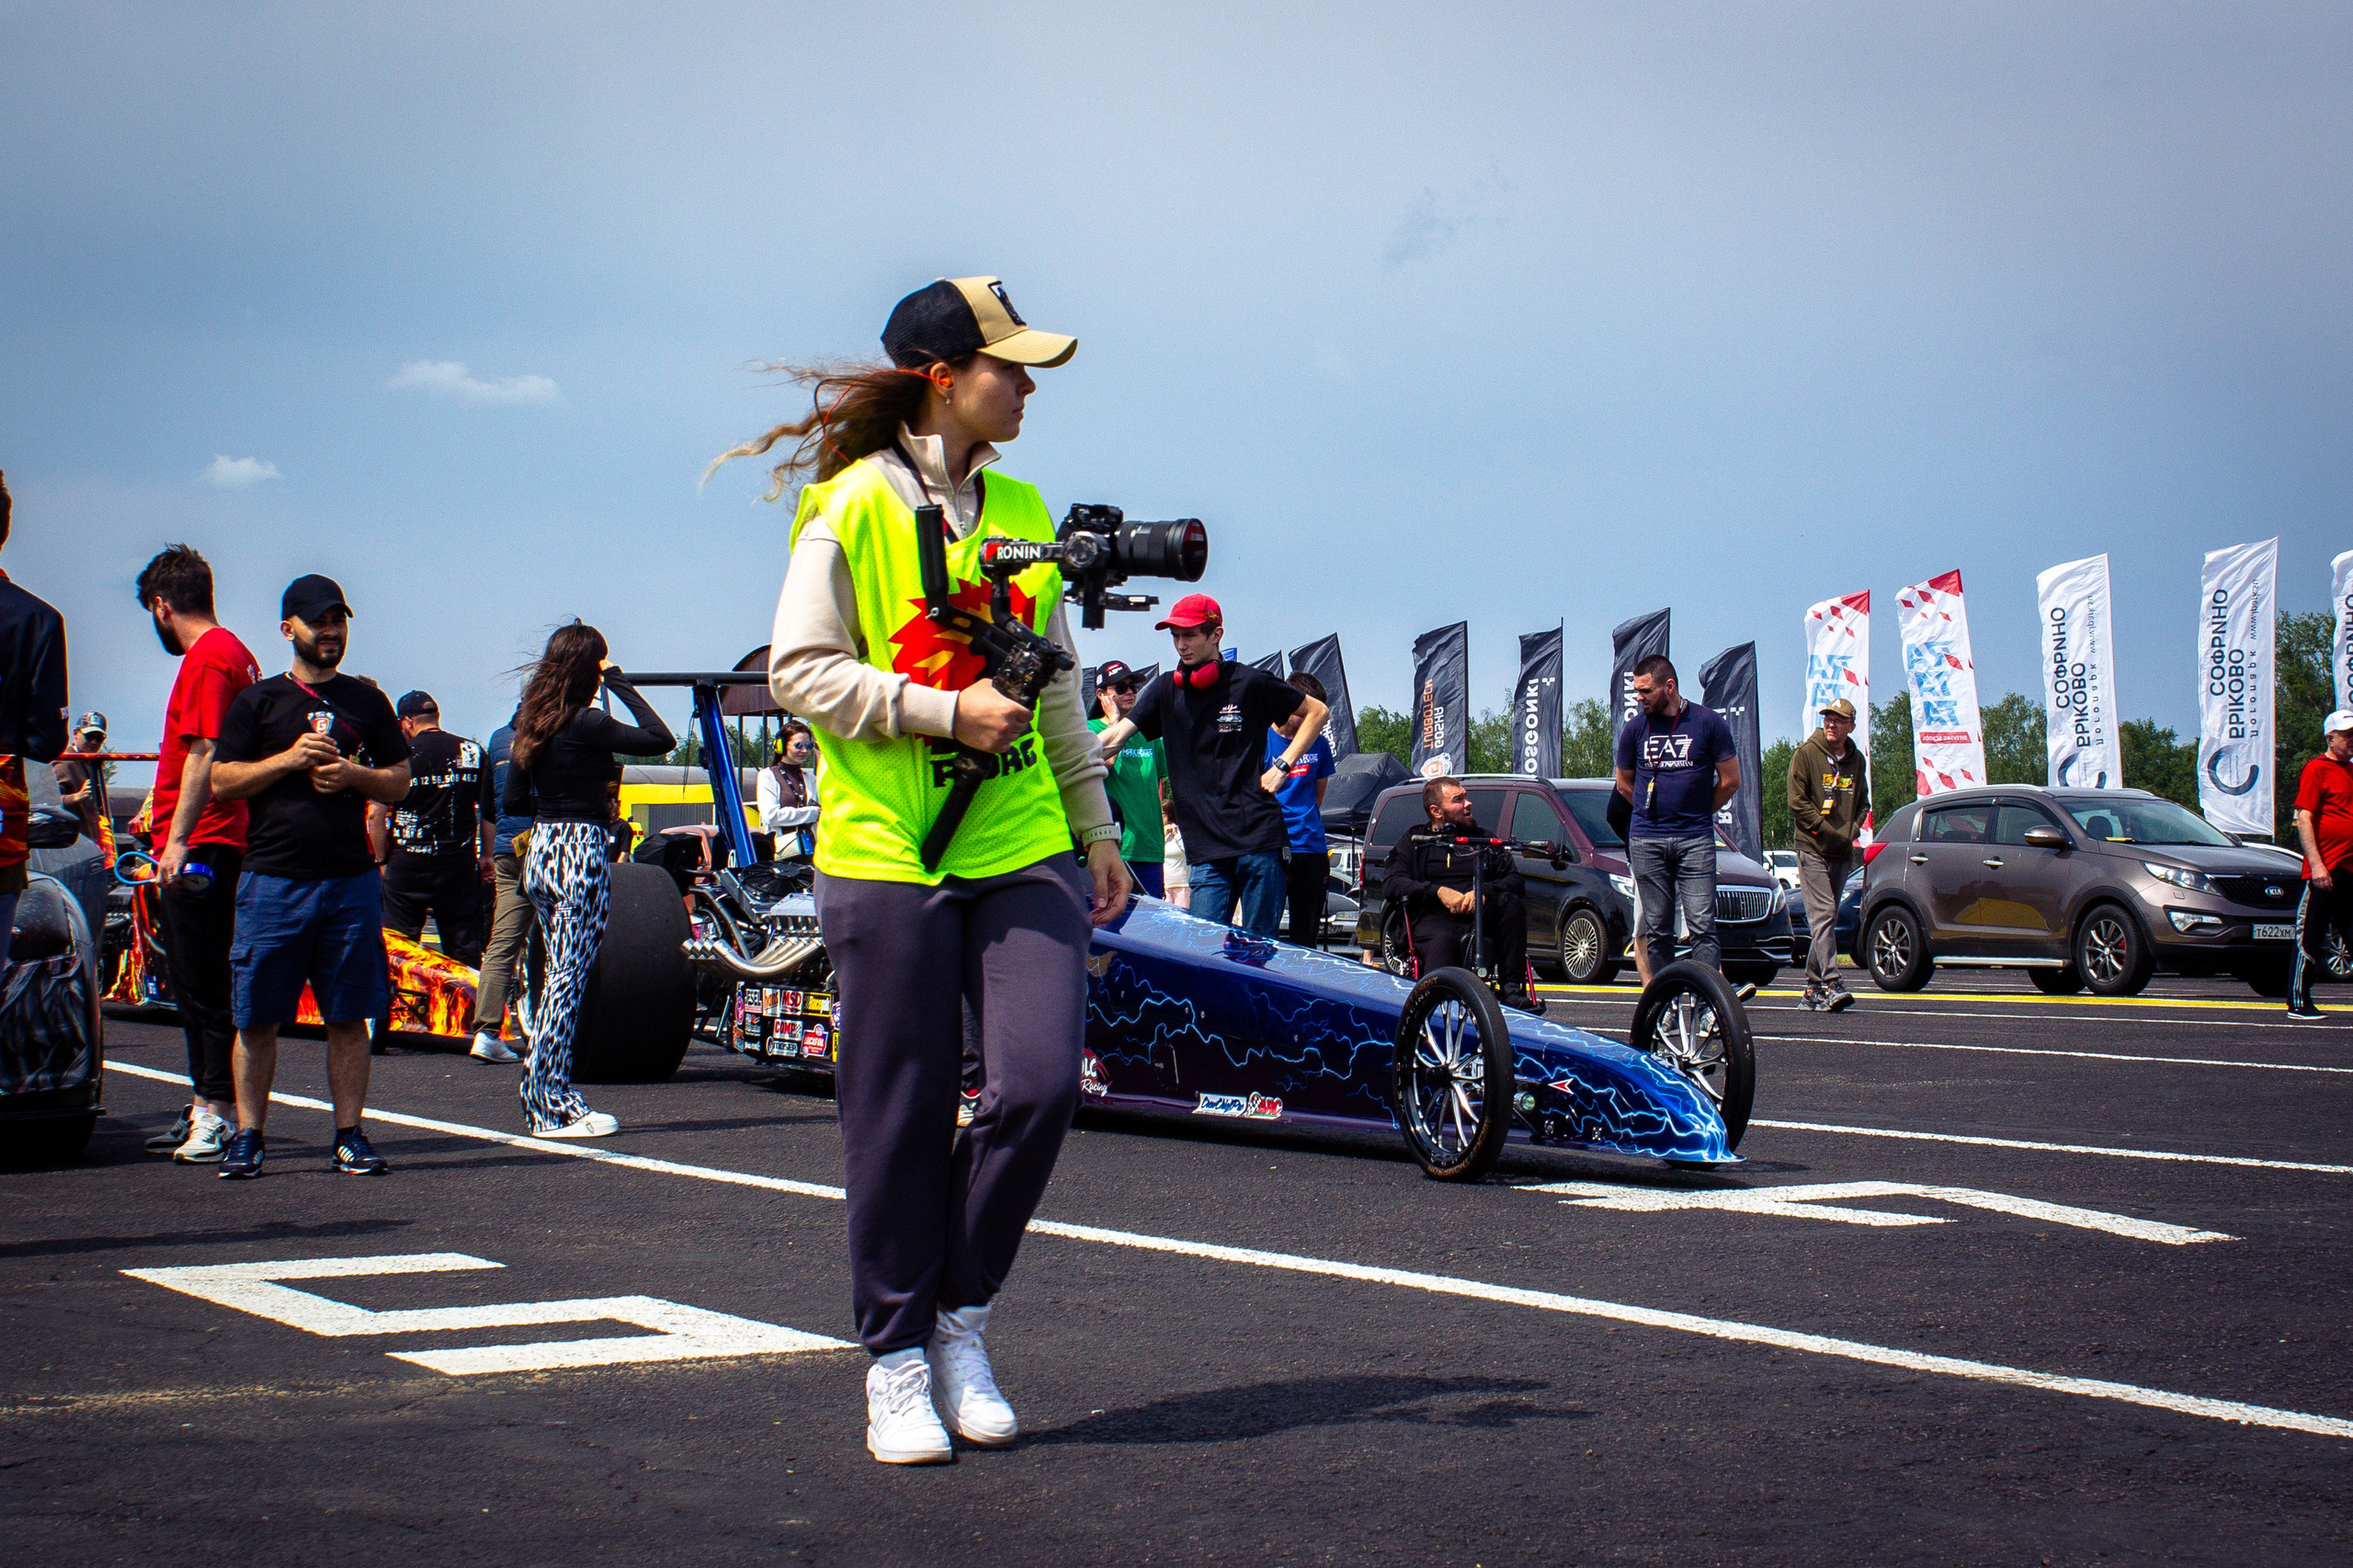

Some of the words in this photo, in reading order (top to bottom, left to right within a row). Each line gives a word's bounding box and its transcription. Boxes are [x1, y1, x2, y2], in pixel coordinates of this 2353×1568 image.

[996, 545, 1041, 560] RONIN
[1643, 738, 1693, 760] EA7
[782, 990, 801, 1007] MSD
[774, 1020, 796, 1035] COMP
[1080, 1078, 1108, 1097] Racing
